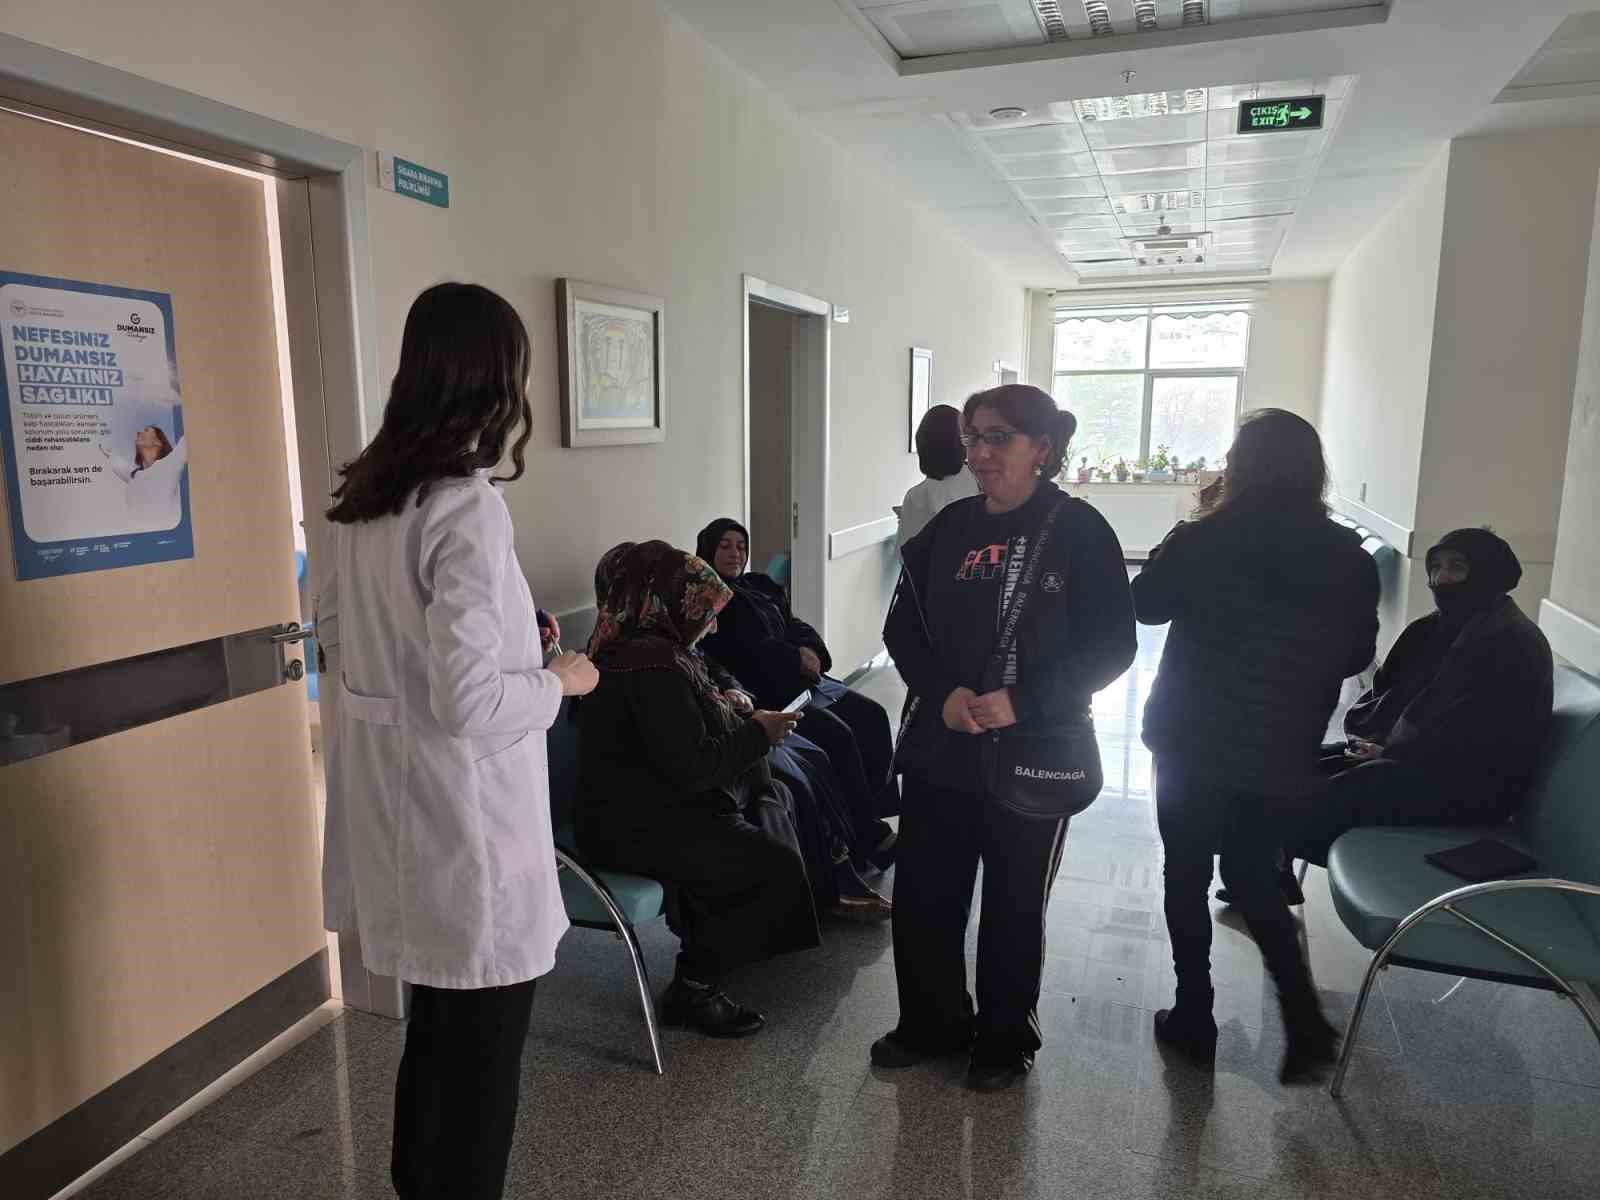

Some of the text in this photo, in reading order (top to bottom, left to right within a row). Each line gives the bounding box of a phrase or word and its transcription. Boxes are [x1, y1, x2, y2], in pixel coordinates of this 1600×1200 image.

[1252, 116, 1275, 127] EXIT
[116, 324, 156, 335] DUMANSIZ
[15, 344, 117, 367] DUMANSIZ
[19, 365, 122, 386] HAYATINIZ
[29, 466, 71, 475] Bırakarak
[1014, 765, 1086, 780] BALENCIAGA
